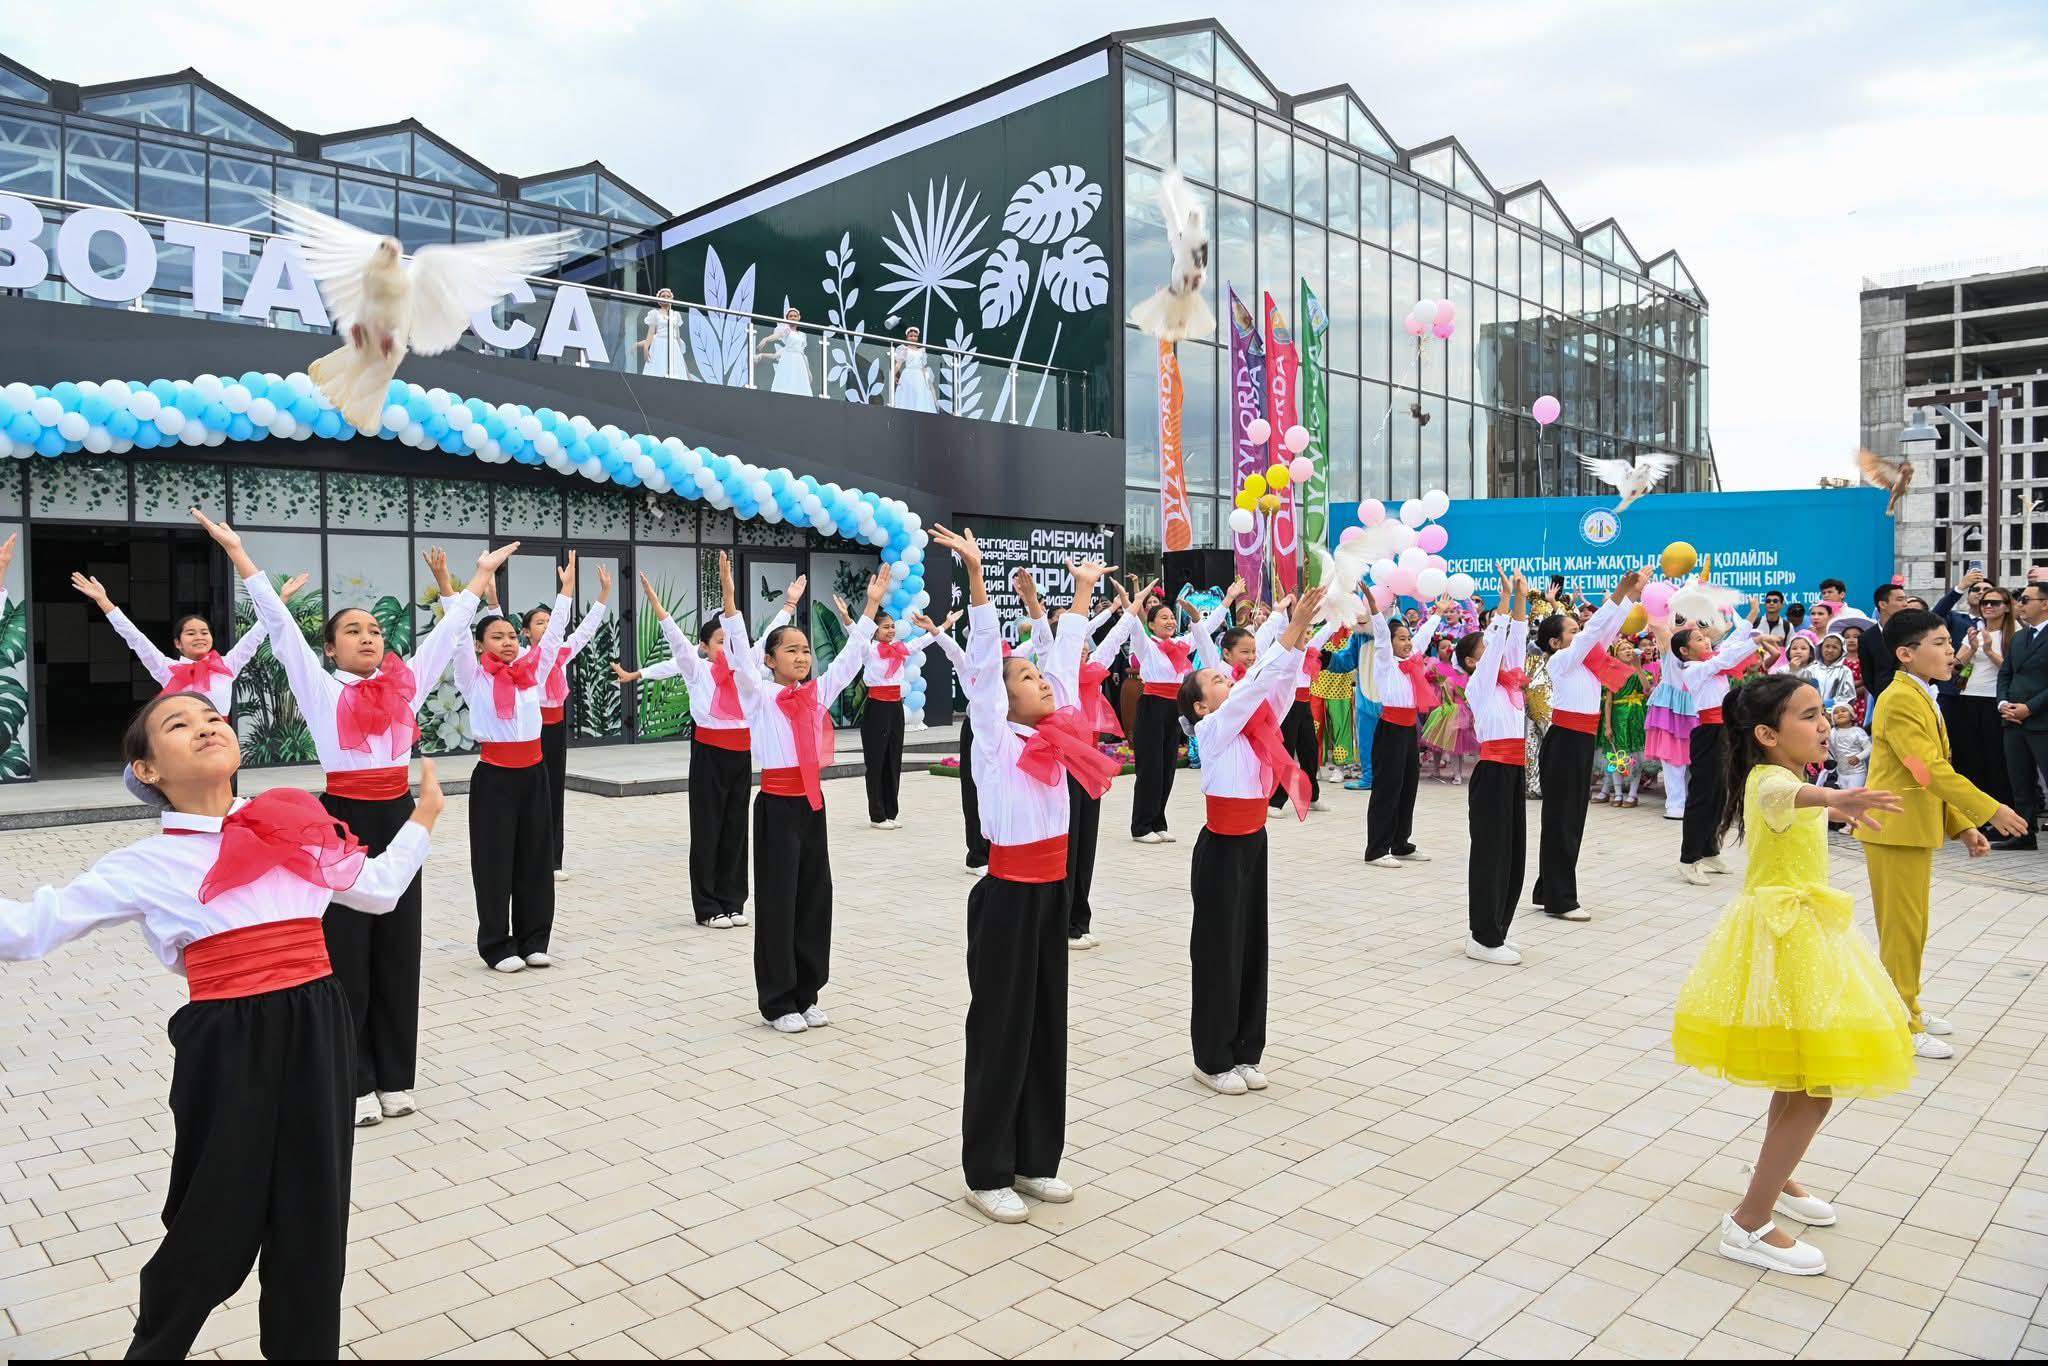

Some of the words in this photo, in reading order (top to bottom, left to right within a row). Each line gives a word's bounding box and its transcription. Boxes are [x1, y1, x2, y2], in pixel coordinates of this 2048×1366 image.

[0, 195, 610, 365] BOTACA
[974, 538, 1028, 551] АНГЛАДЕШ
[1031, 529, 1105, 550] АМЕРИКА
[1447, 558, 1493, 573] СКЕЛЕҢ
[1564, 554, 1643, 571] ЖАН-ЖАҚТЫ
[1714, 549, 1778, 568] ҚОЛАЙЛЫ
[1765, 571, 1797, 585] БІРІ»
